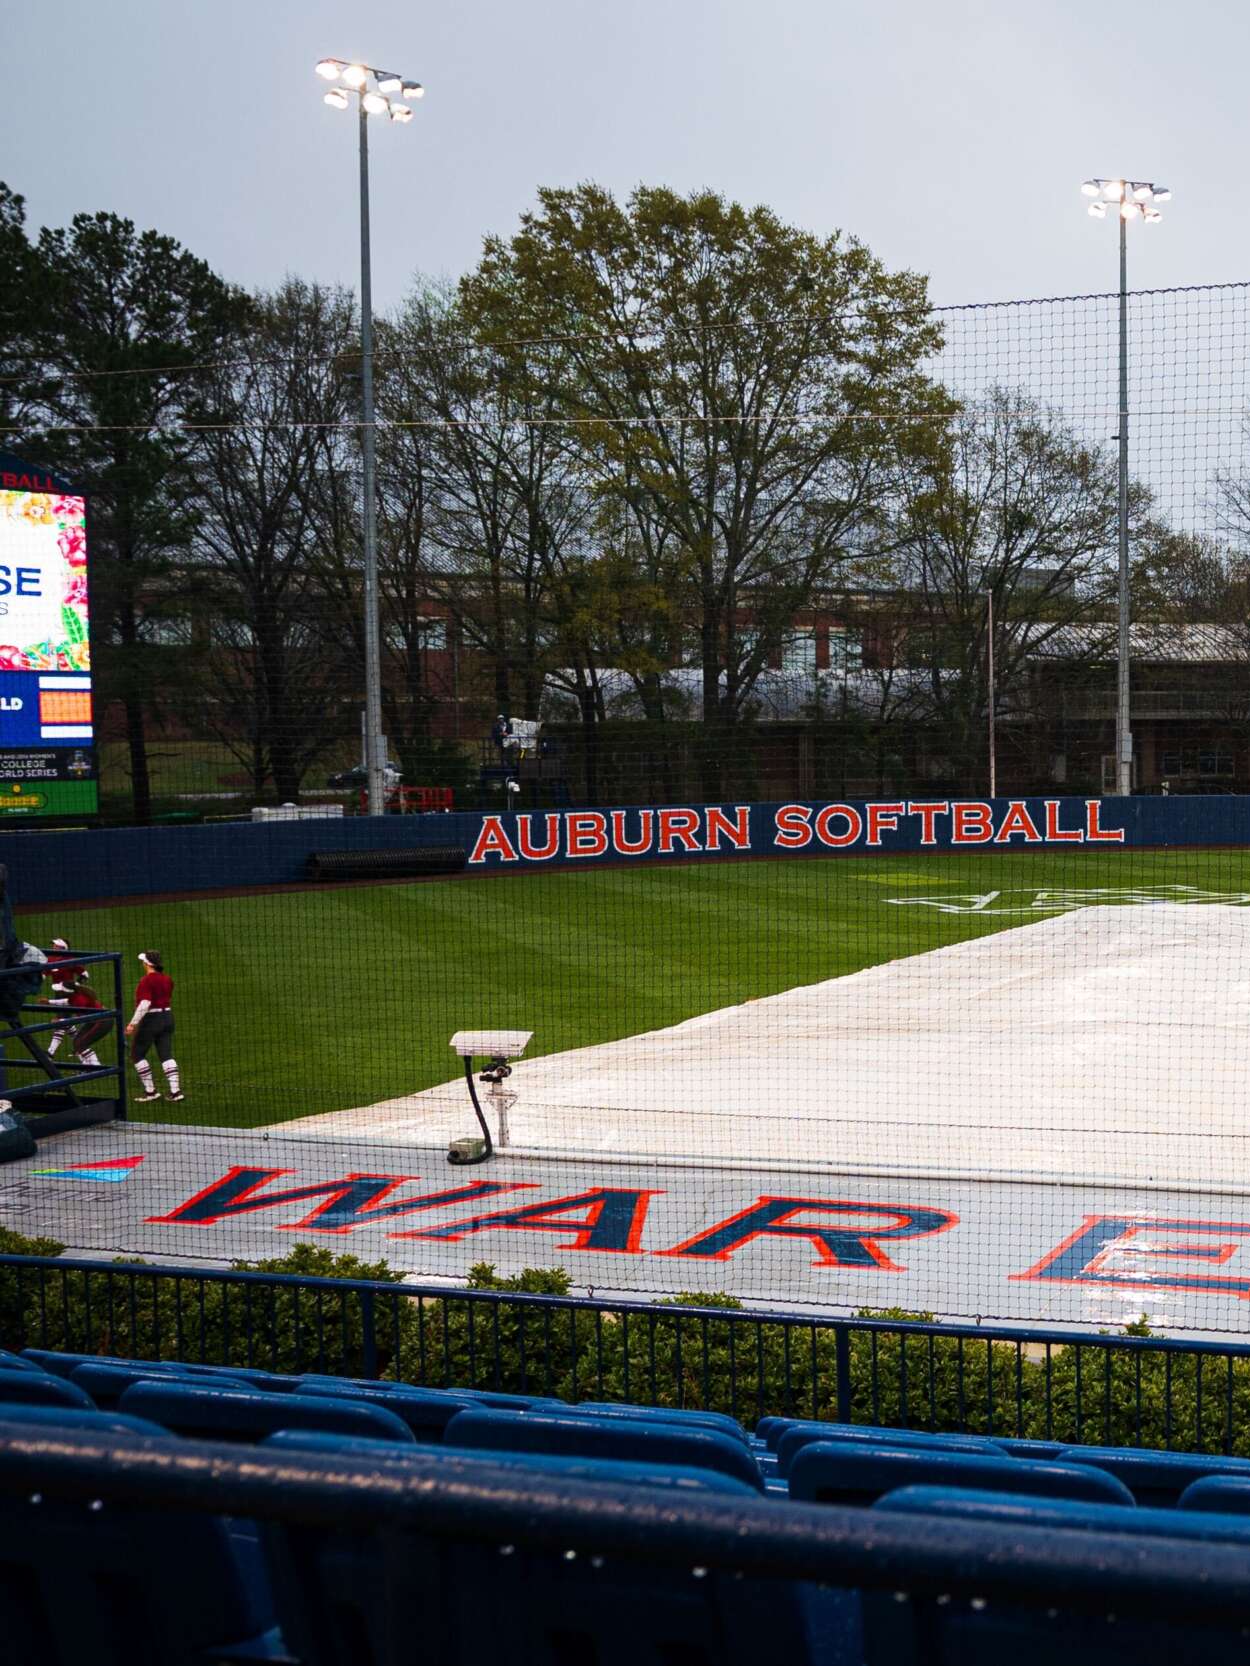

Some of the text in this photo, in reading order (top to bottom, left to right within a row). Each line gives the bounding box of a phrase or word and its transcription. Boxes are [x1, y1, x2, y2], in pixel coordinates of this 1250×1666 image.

[1, 760, 46, 769] COLLEGE
[25, 769, 58, 777] SERIES
[468, 800, 1124, 863] AUBURN SOFTBALL
[144, 1165, 959, 1272] WAR
